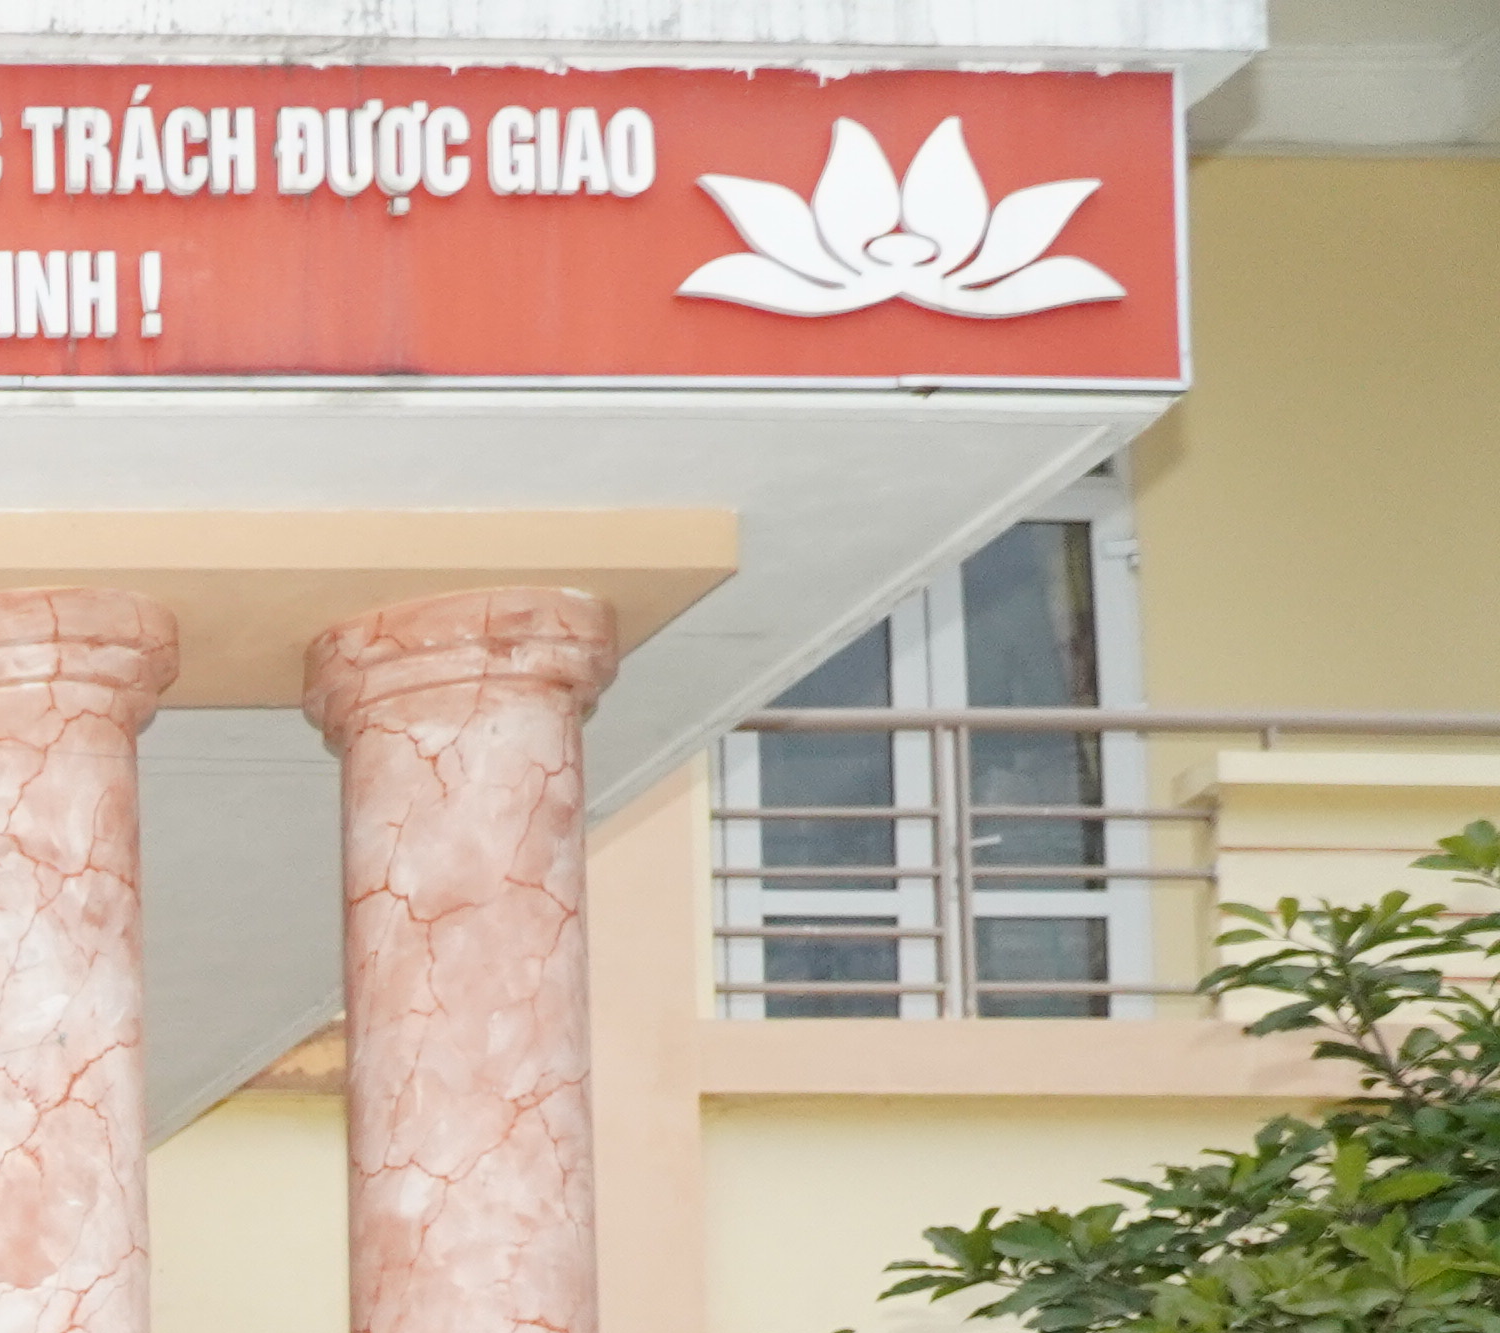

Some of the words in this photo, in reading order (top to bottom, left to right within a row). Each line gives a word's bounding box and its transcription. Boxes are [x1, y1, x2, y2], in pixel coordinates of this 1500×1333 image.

[23, 82, 257, 197] TRÁCH
[275, 99, 471, 216] ĐƯỢC
[486, 106, 656, 198] GIAO
[138, 251, 162, 338] !
